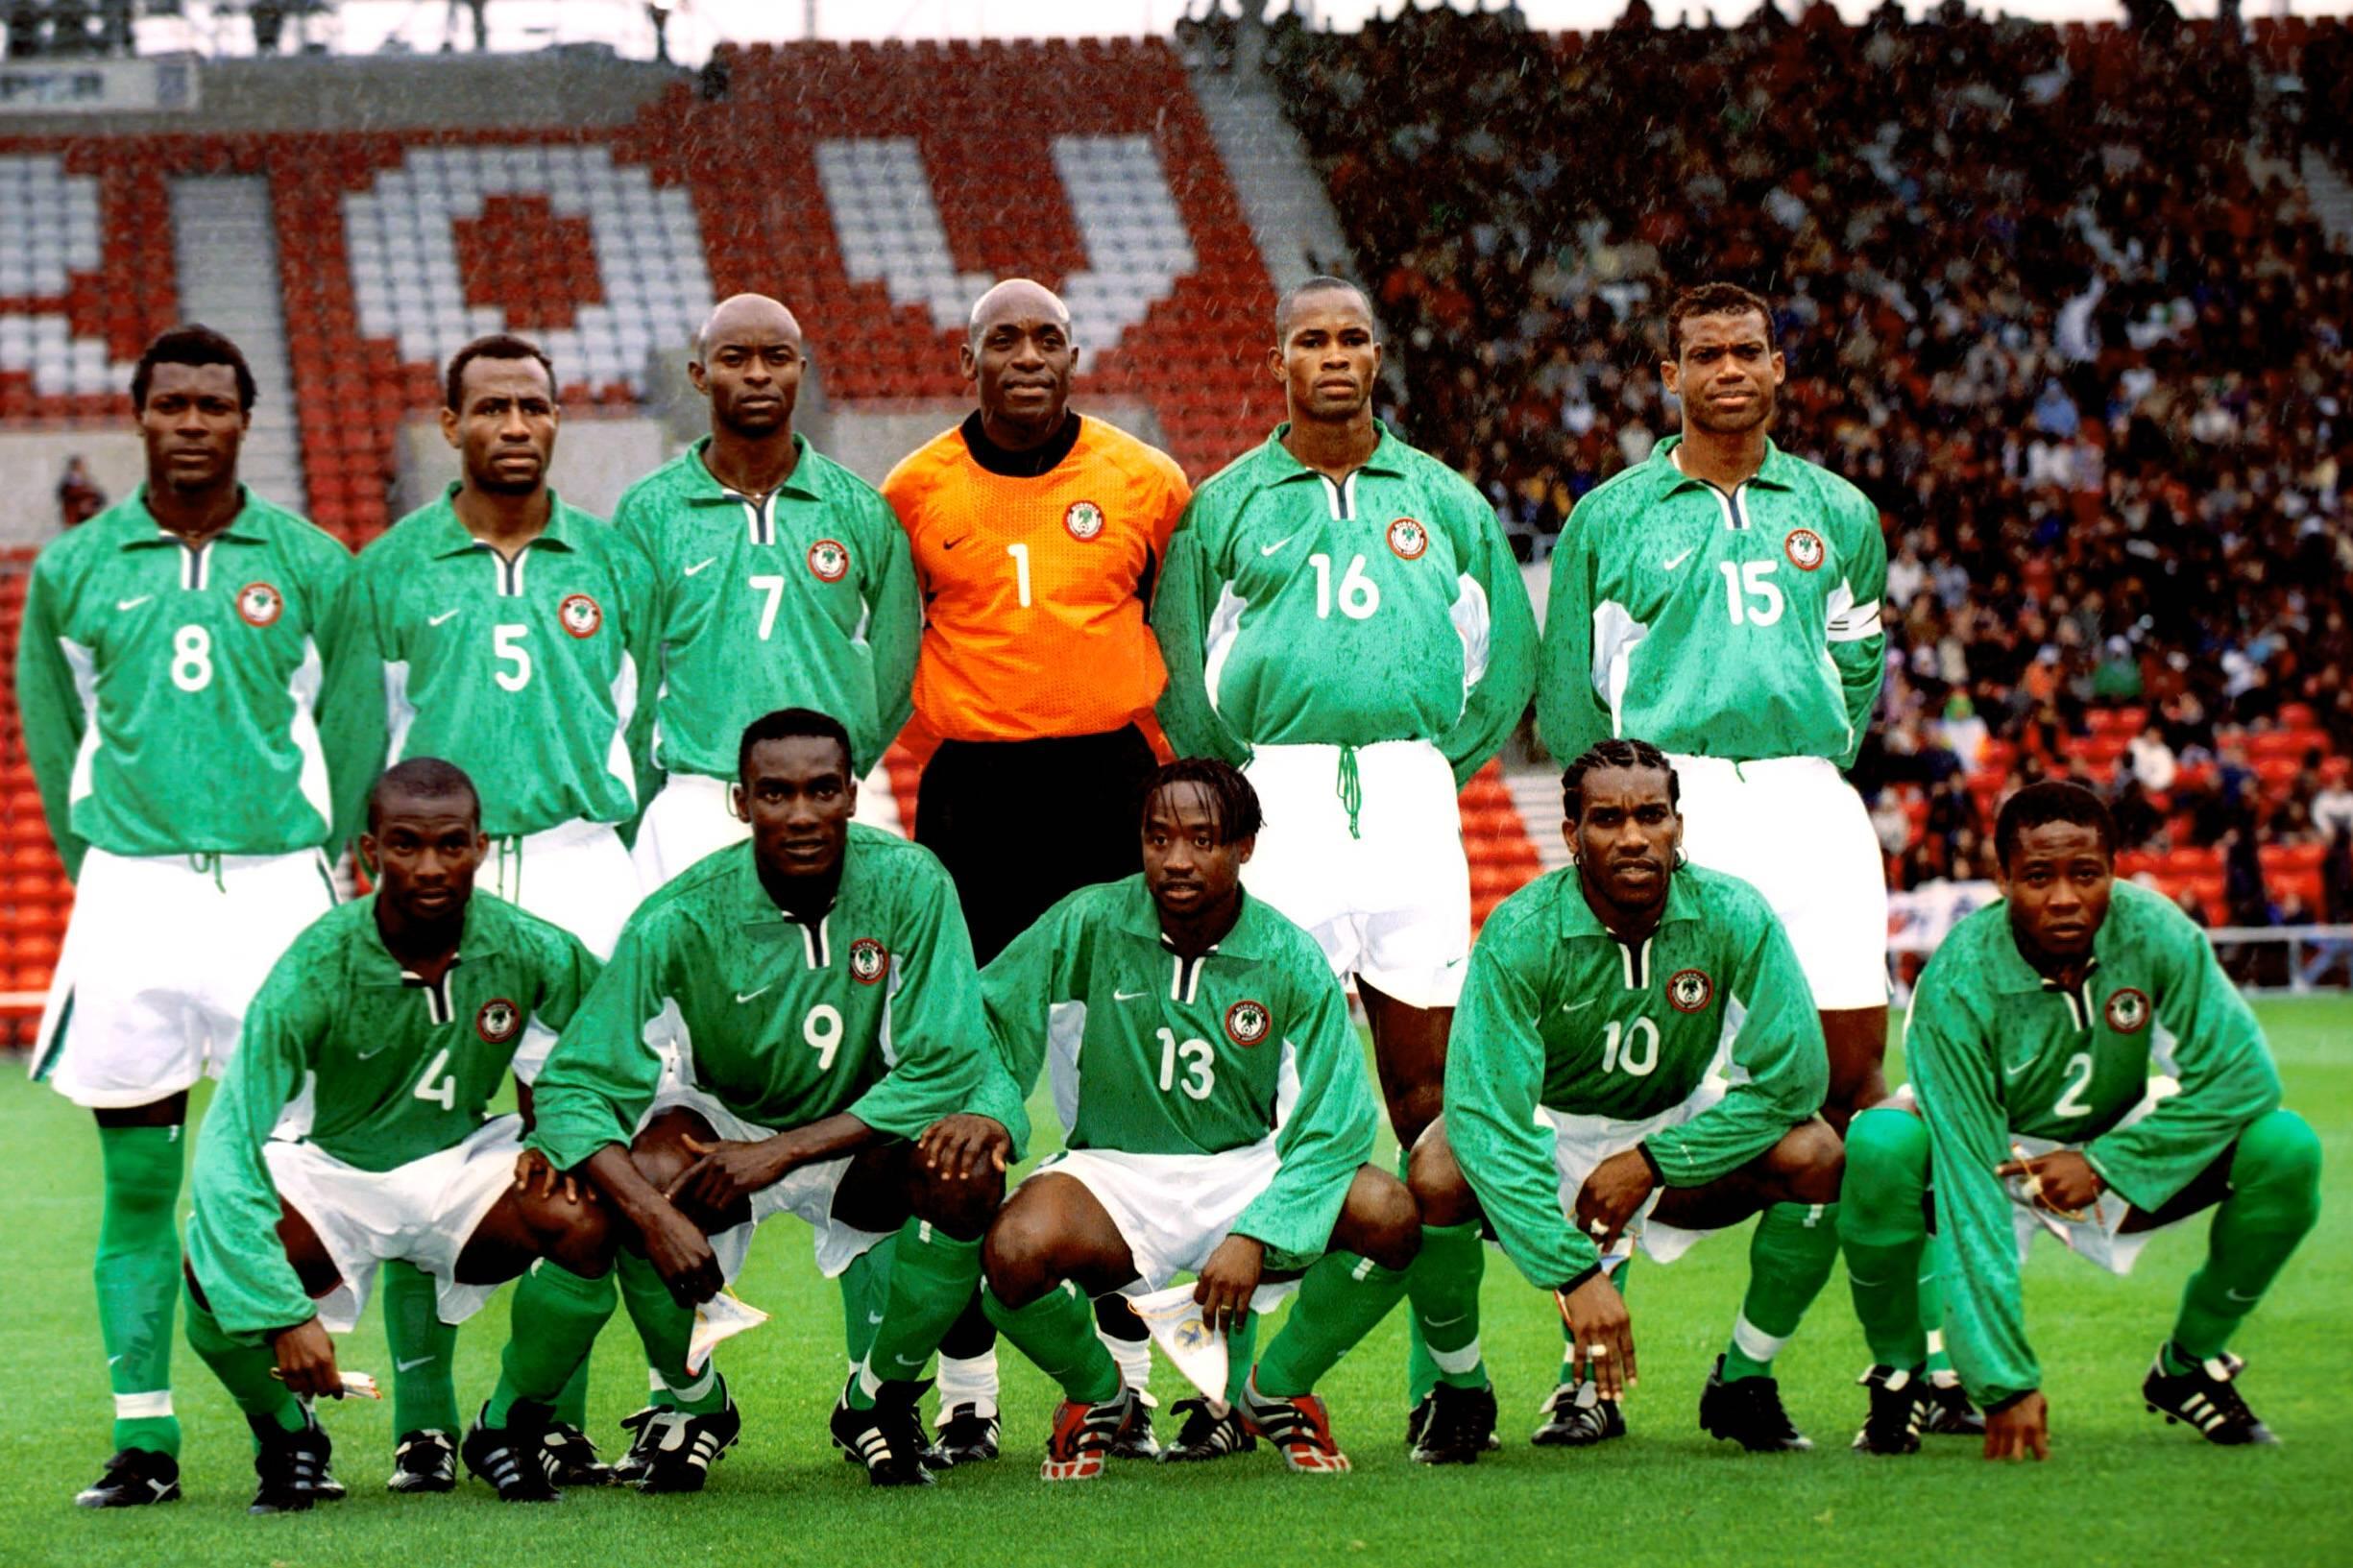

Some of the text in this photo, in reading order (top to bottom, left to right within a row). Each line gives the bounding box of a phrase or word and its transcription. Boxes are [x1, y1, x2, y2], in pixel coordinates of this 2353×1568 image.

[747, 574, 786, 641] 7
[1007, 543, 1031, 608] 1
[1308, 553, 1381, 620] 16
[1719, 560, 1784, 627] 15
[170, 624, 213, 692] 8
[492, 623, 533, 692] 5
[803, 1003, 843, 1071] 9
[1155, 1027, 1215, 1100] 13
[1602, 1016, 1660, 1076] 10
[413, 1049, 455, 1110] 4
[2053, 1053, 2093, 1117] 2
